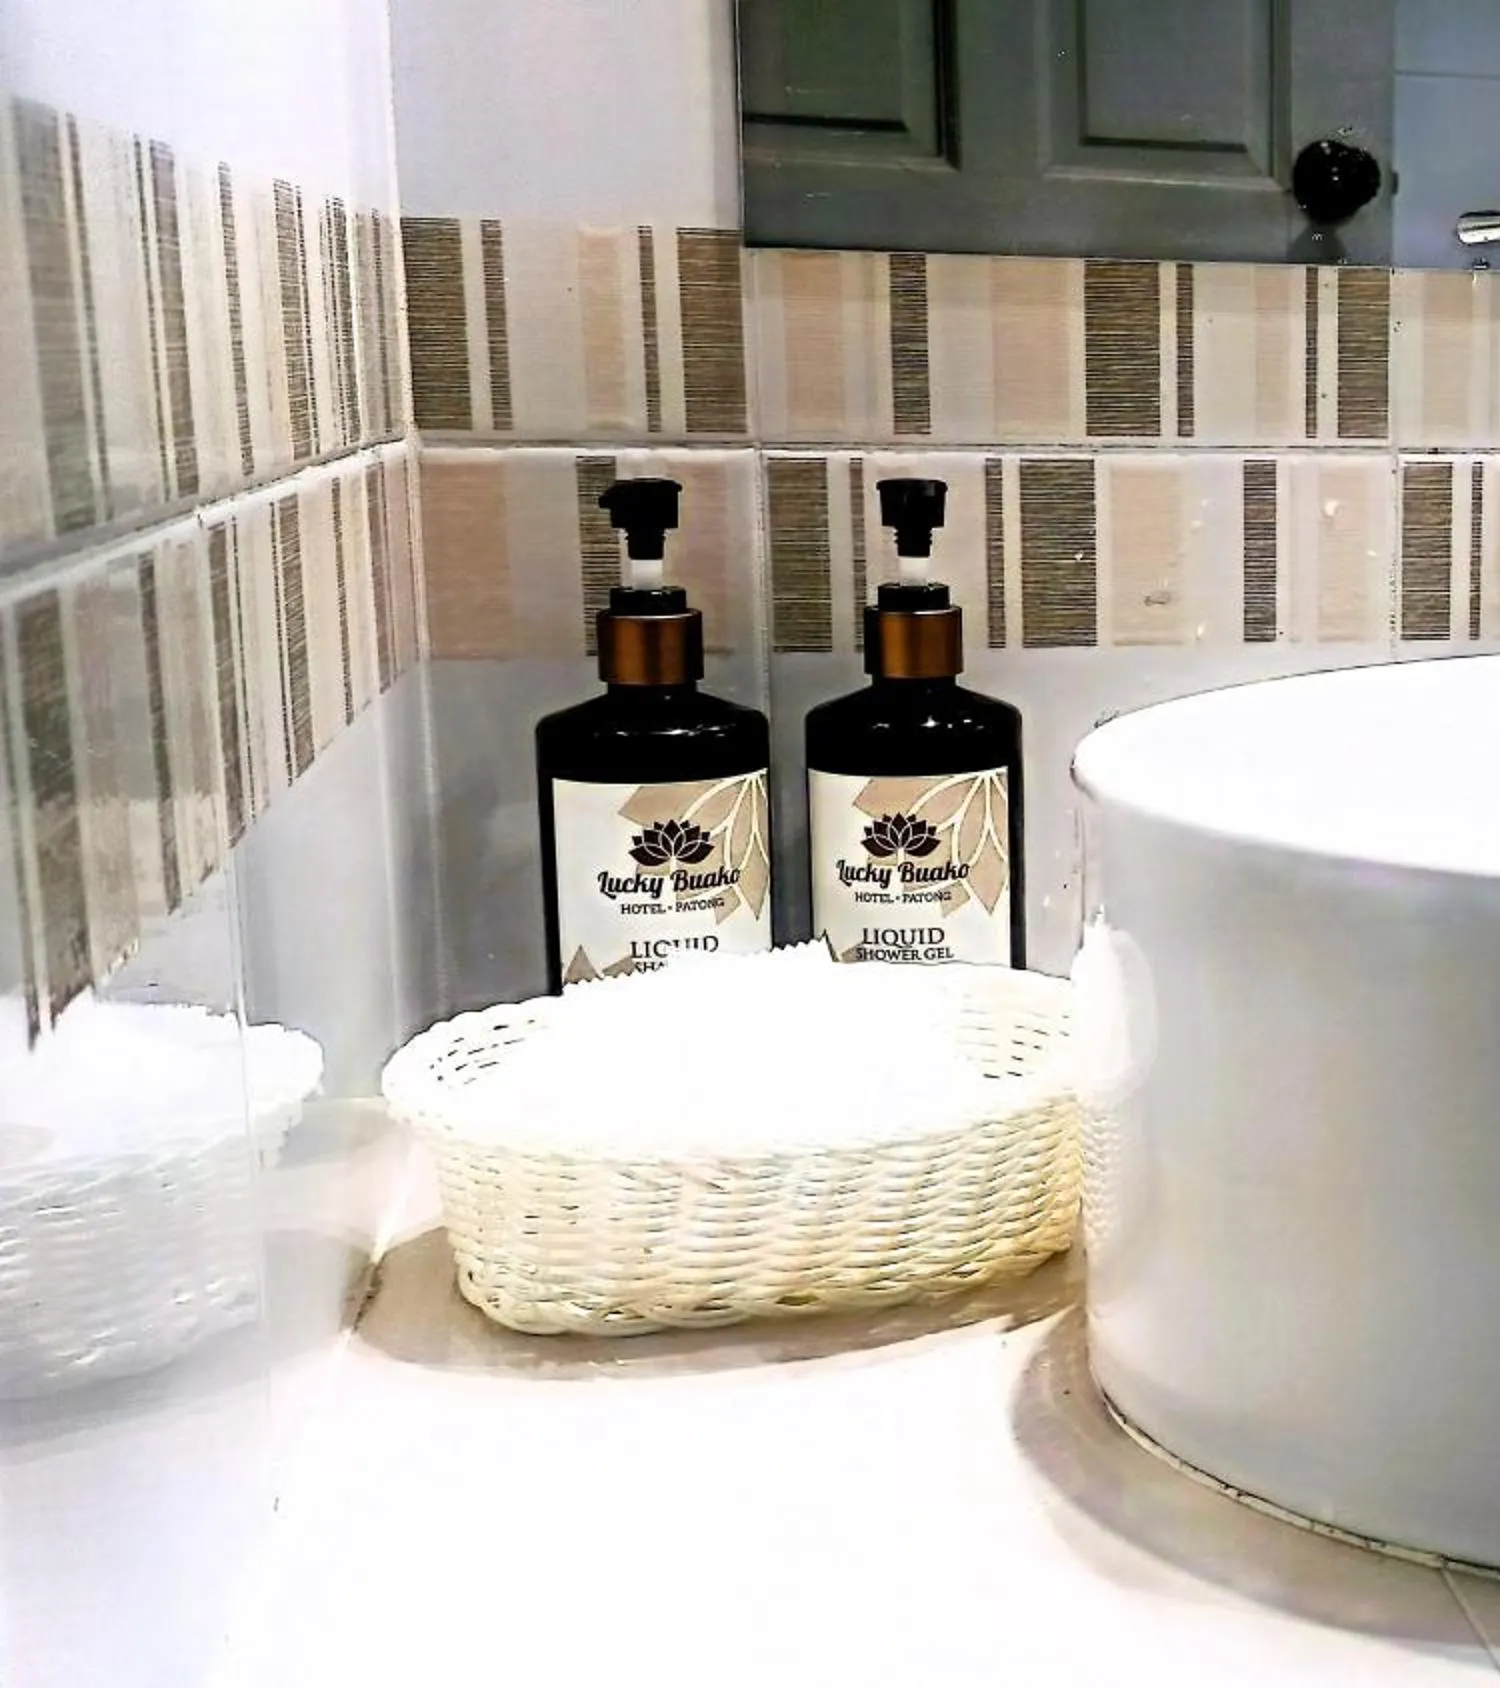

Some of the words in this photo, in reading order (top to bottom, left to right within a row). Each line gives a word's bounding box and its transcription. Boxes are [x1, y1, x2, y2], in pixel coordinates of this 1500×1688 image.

[597, 871, 664, 900] Lucky
[669, 867, 740, 892] Buako
[835, 860, 892, 888] Lucky
[897, 861, 970, 883] Buako
[620, 902, 667, 915] HOTEL
[675, 897, 726, 912] PATONG
[854, 892, 895, 903] HOTEL
[902, 890, 952, 903] PATONG
[862, 927, 945, 949] LIQUID
[856, 948, 921, 961] SHOWER
[924, 947, 954, 960] GEL
